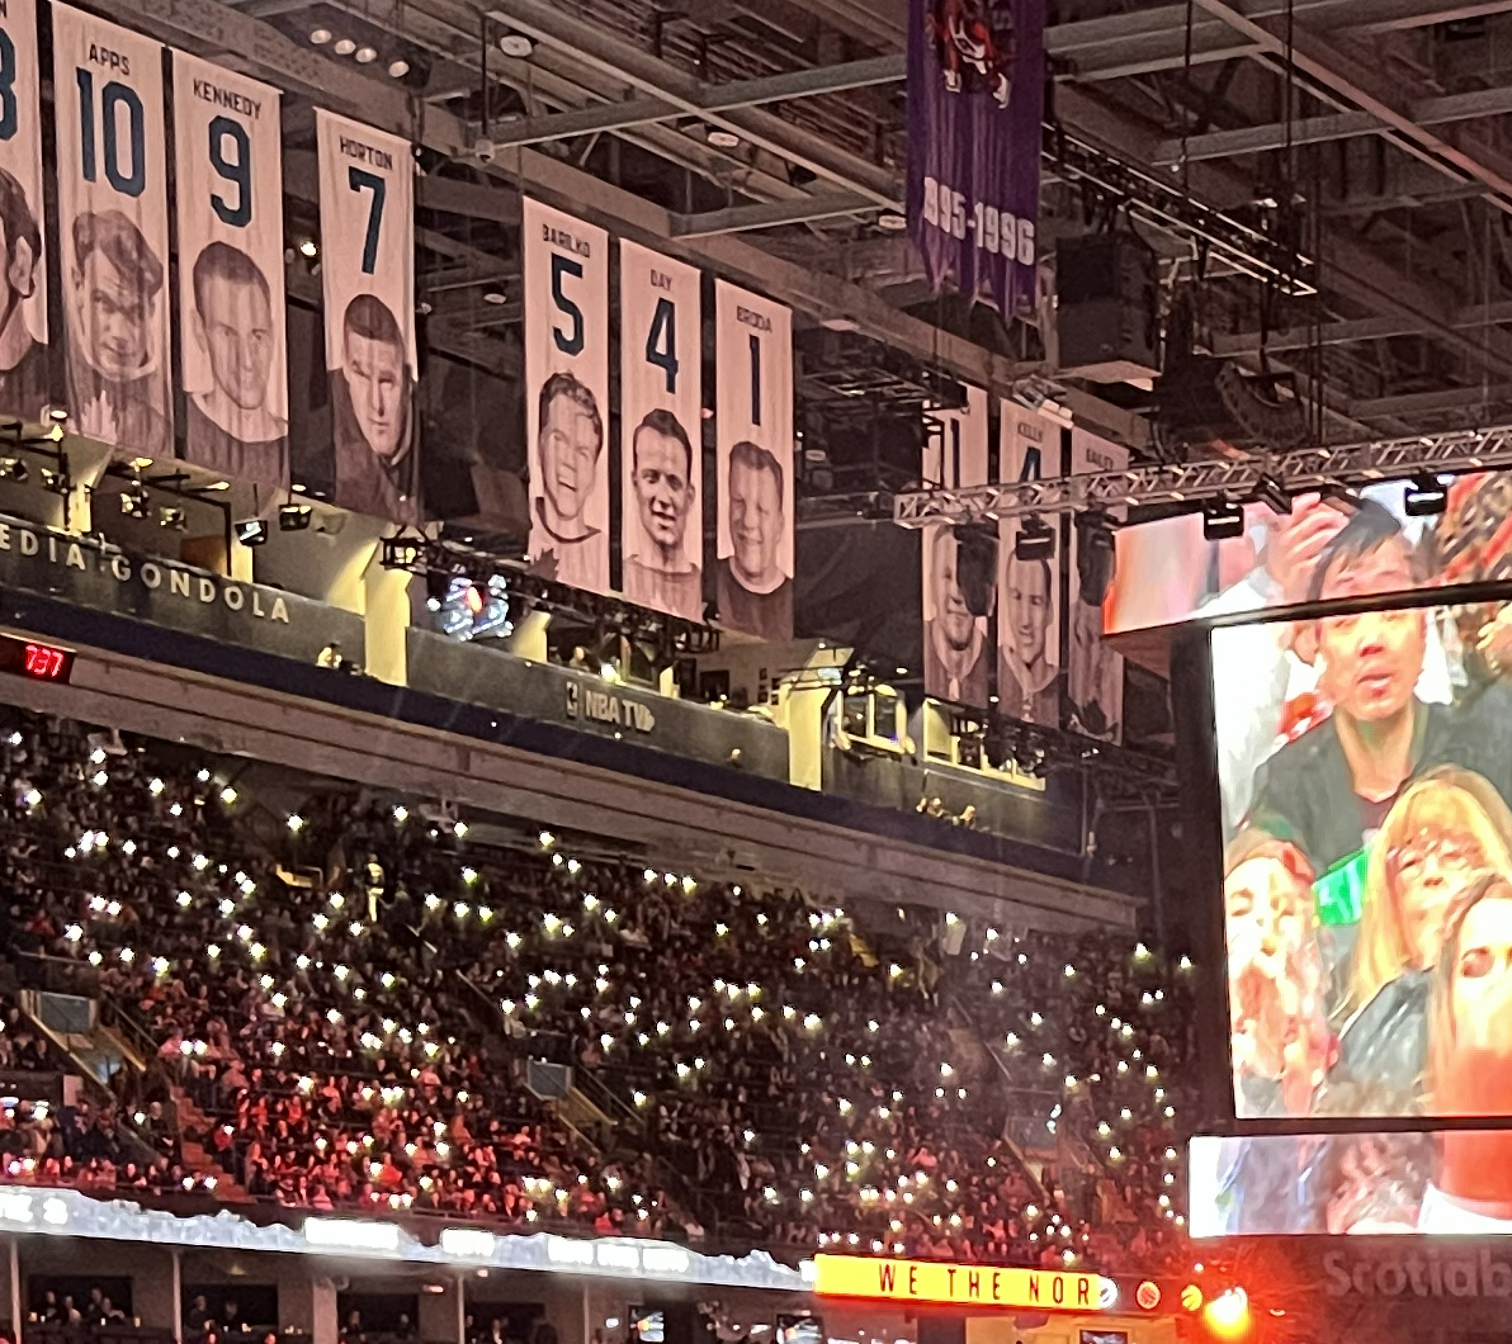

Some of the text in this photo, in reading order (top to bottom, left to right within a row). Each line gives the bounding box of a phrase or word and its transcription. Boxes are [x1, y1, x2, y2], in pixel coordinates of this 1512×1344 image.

[89, 44, 130, 75] APPS
[76, 66, 146, 198] 10
[193, 78, 262, 120] KENNEDY
[208, 115, 252, 228] 9
[339, 135, 394, 171] HORTON
[348, 166, 386, 274] 7
[551, 253, 584, 357] 5
[650, 268, 673, 292] DAY
[646, 297, 679, 394] 4
[749, 334, 761, 426] 1
[112, 554, 290, 624] GONDOLA
[585, 690, 621, 724] NBA
[878, 1263, 919, 1296] WE
[948, 1268, 1002, 1302] THE
